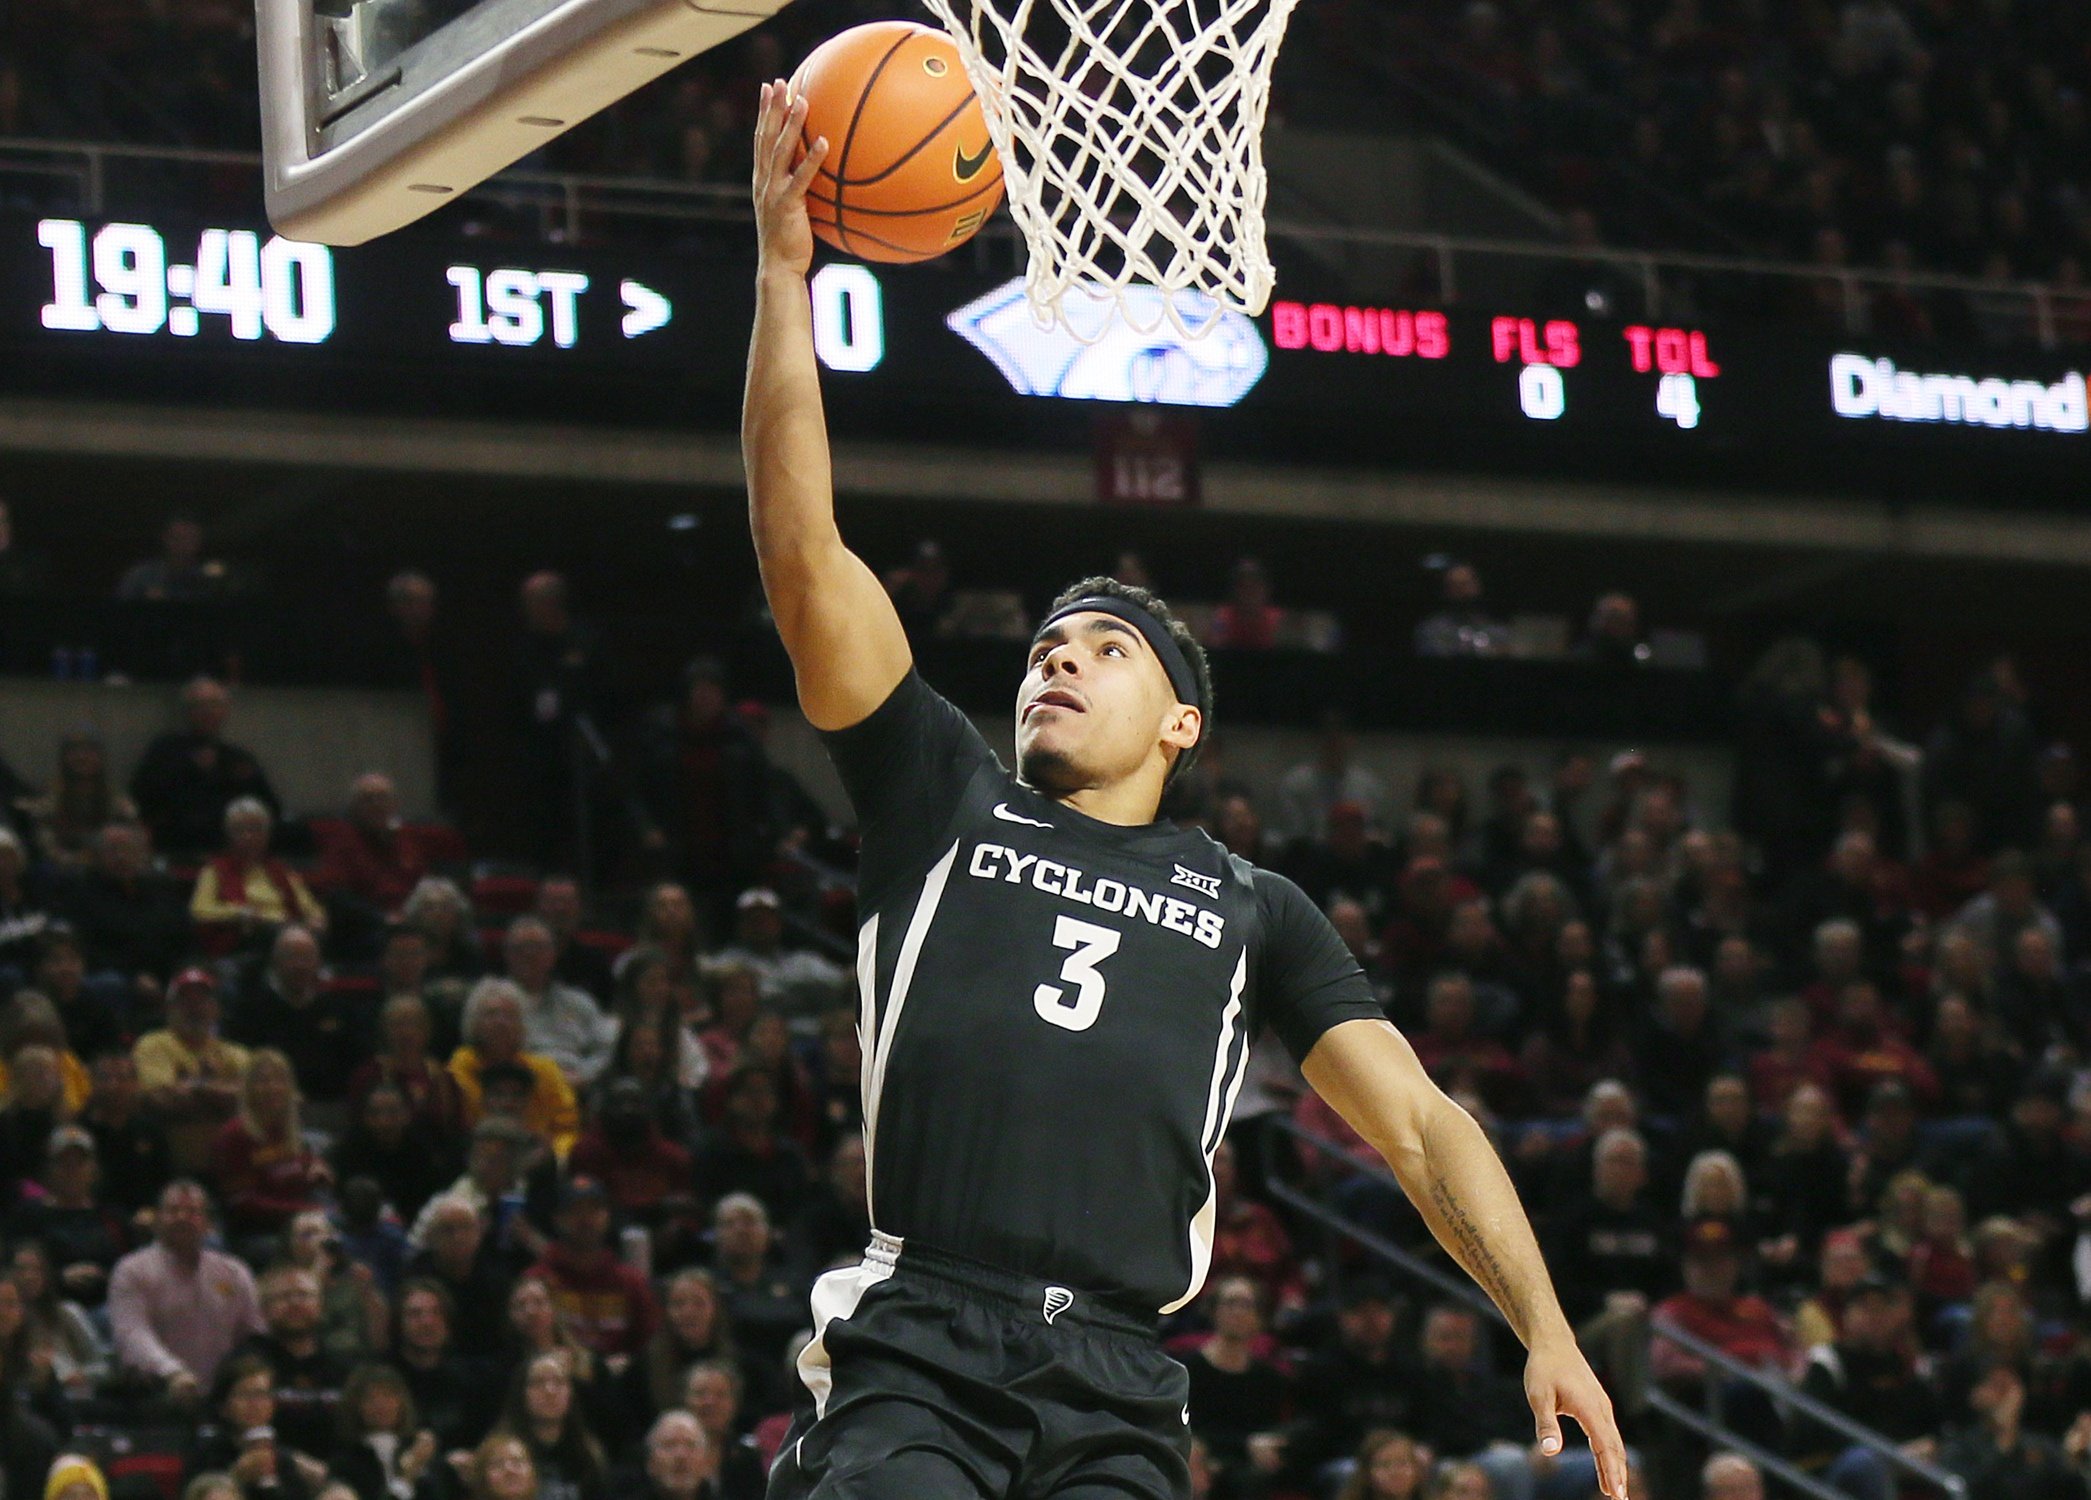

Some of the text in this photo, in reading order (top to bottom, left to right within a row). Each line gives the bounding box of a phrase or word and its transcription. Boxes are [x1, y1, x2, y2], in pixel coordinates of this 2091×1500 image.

[38, 219, 334, 344] 19:40
[447, 266, 589, 348] 1ST
[1272, 301, 1449, 359] BONUS
[1491, 316, 1582, 368] FLS
[1623, 325, 1720, 378] TOL
[1519, 363, 1566, 420] 0
[1656, 373, 1700, 429] 4
[1830, 353, 2088, 432] Diamond
[969, 842, 1225, 949] CYCLONES
[1033, 914, 1122, 1032] 3
